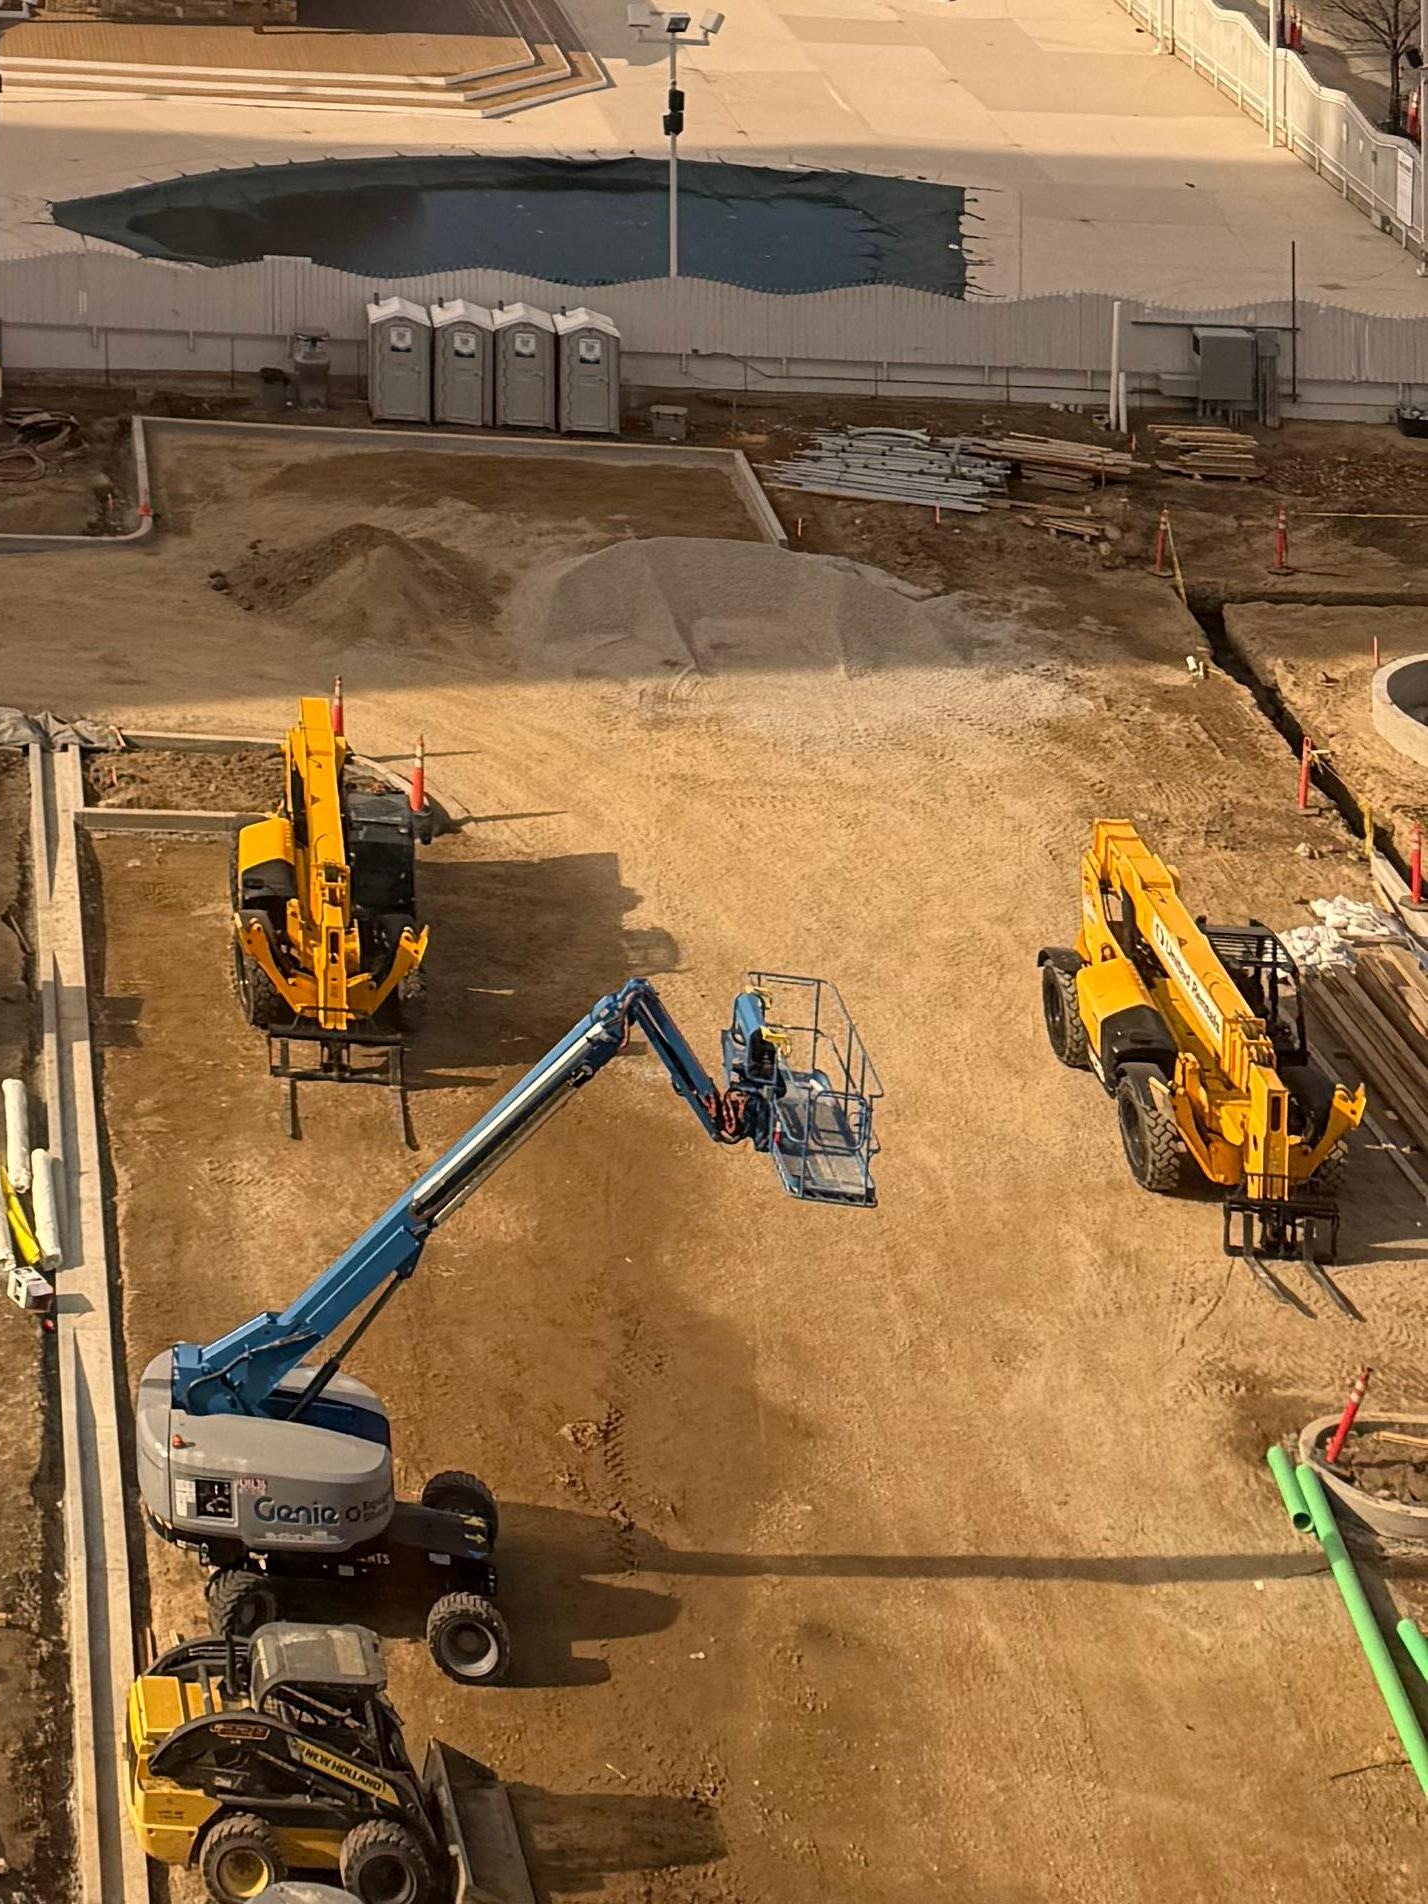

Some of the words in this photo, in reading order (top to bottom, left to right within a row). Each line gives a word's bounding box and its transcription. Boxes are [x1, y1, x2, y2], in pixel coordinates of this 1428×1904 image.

[254, 1495, 340, 1525] Genie
[304, 1749, 331, 1767] NEW
[330, 1758, 383, 1792] HOLLAND
